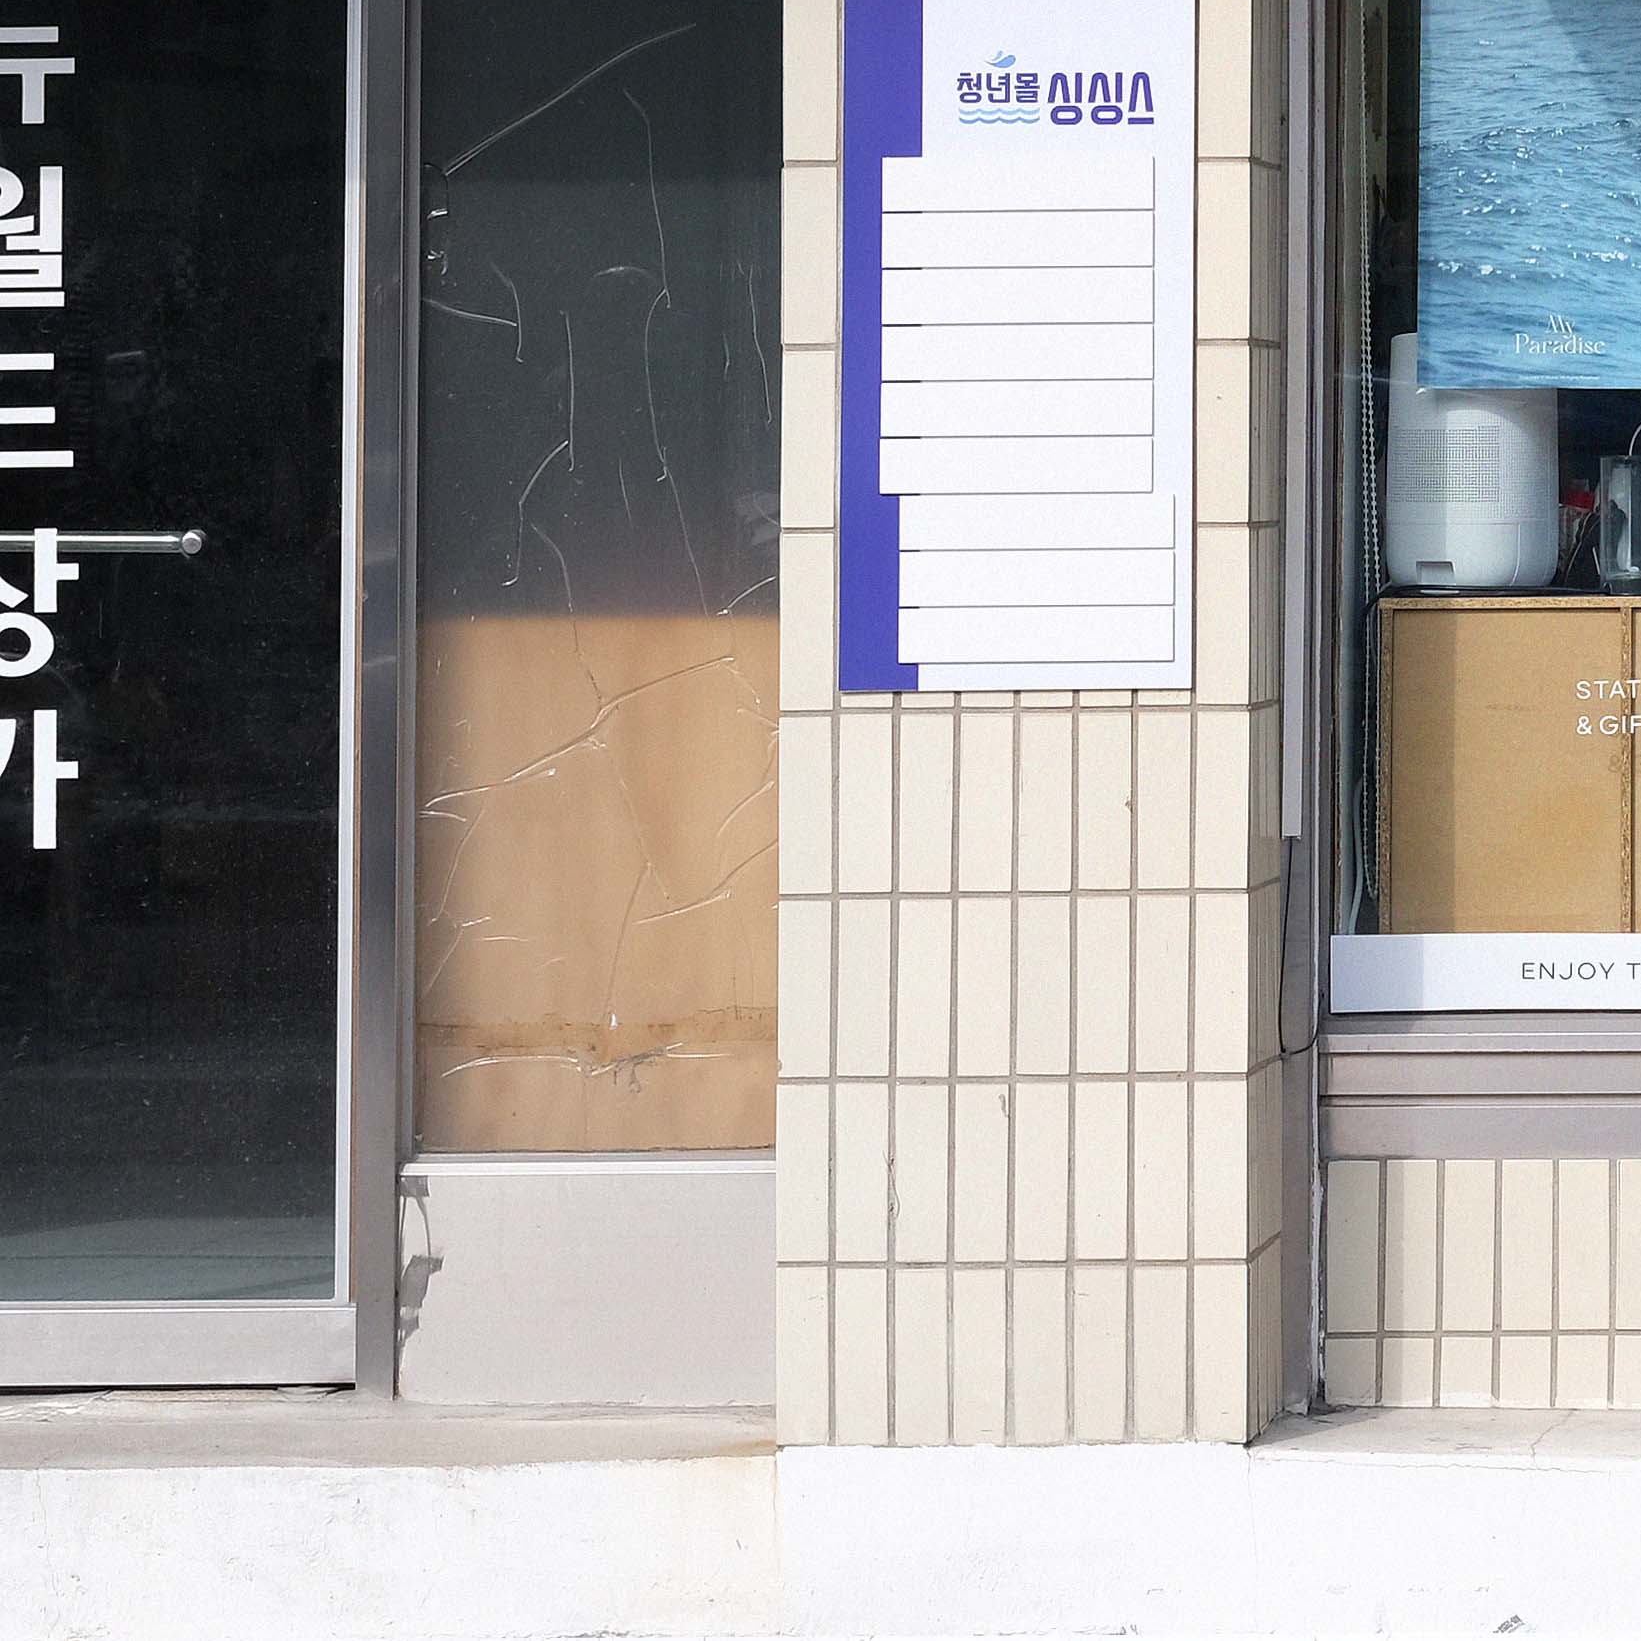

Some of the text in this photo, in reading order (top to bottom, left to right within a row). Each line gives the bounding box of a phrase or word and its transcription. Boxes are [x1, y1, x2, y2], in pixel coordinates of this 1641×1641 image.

[957, 71, 1155, 125] 청년몰 싱싱스
[1545, 314, 1576, 339] My
[1514, 333, 1606, 355] Paradise
[1576, 715, 1593, 735] &
[1521, 962, 1615, 981] ENJOY
